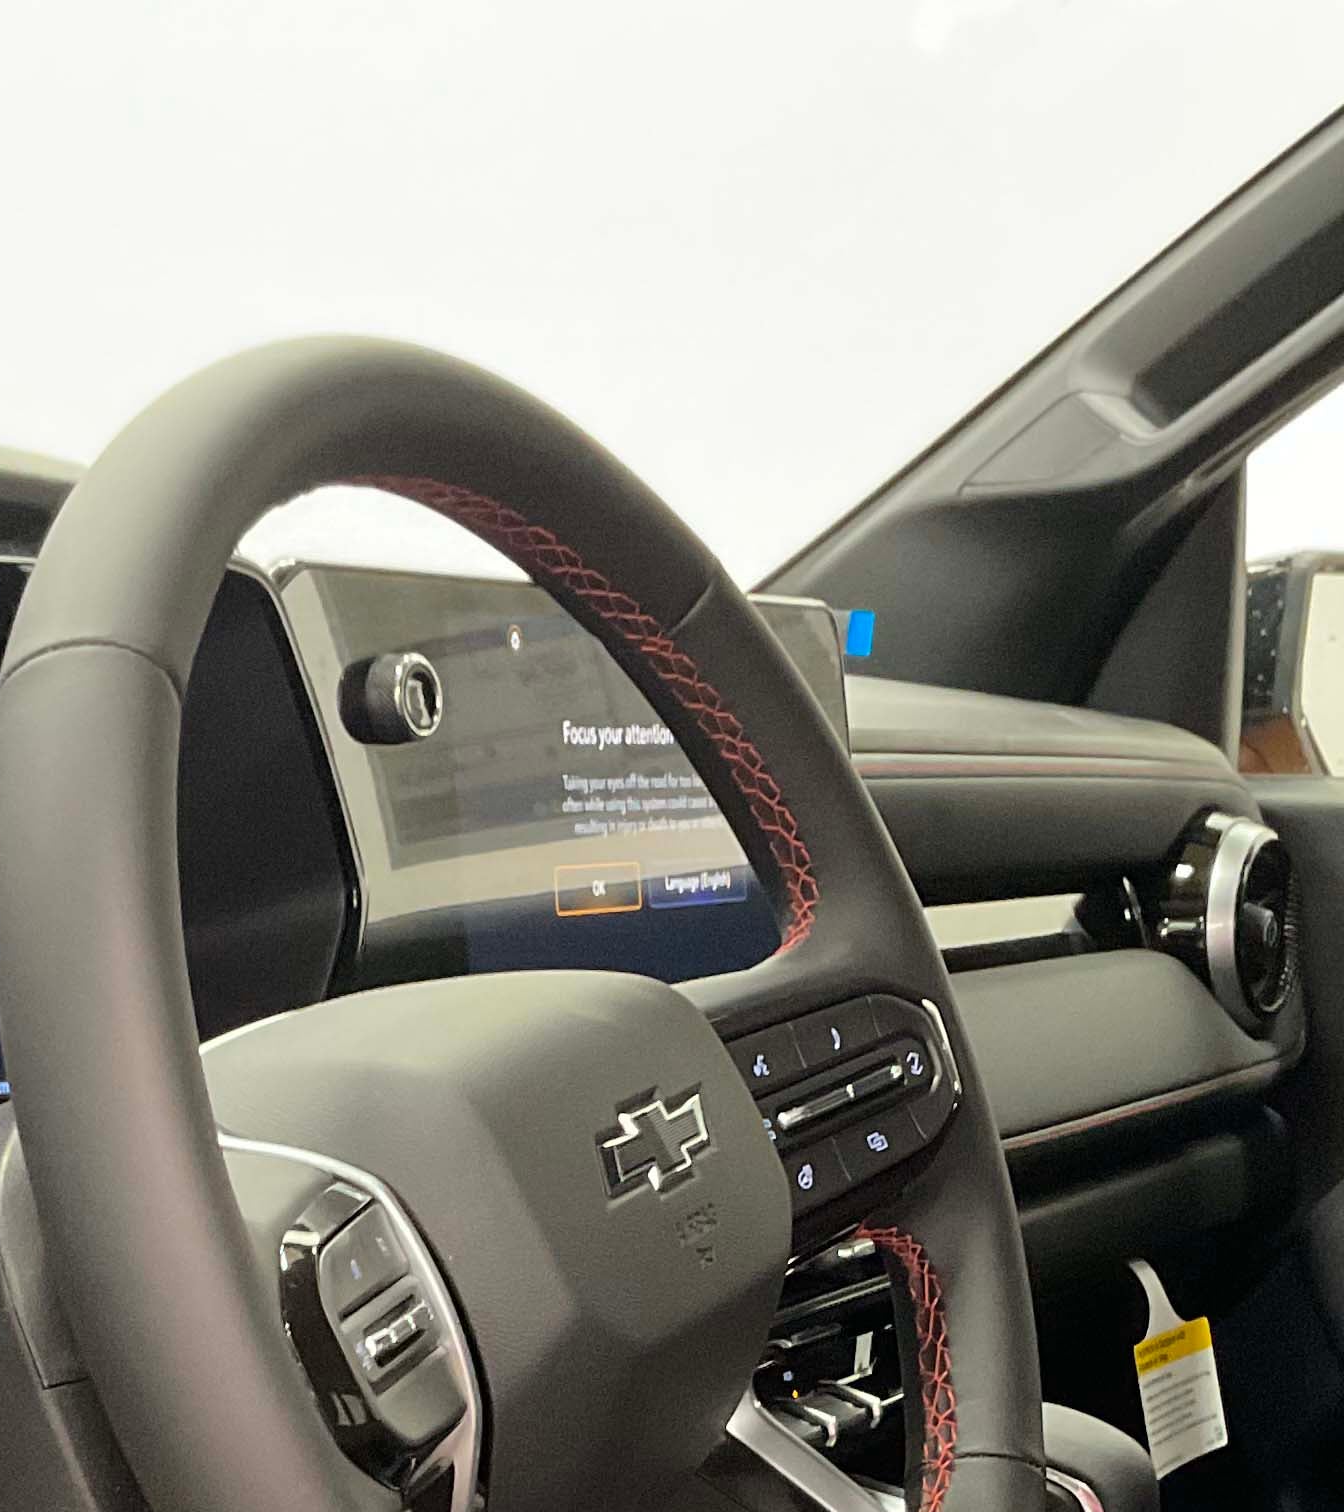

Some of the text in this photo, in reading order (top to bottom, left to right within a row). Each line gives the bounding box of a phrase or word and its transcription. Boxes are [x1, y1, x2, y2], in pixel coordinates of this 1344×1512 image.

[562, 720, 598, 745] Focus
[598, 726, 623, 750] your
[591, 880, 606, 897] OK
